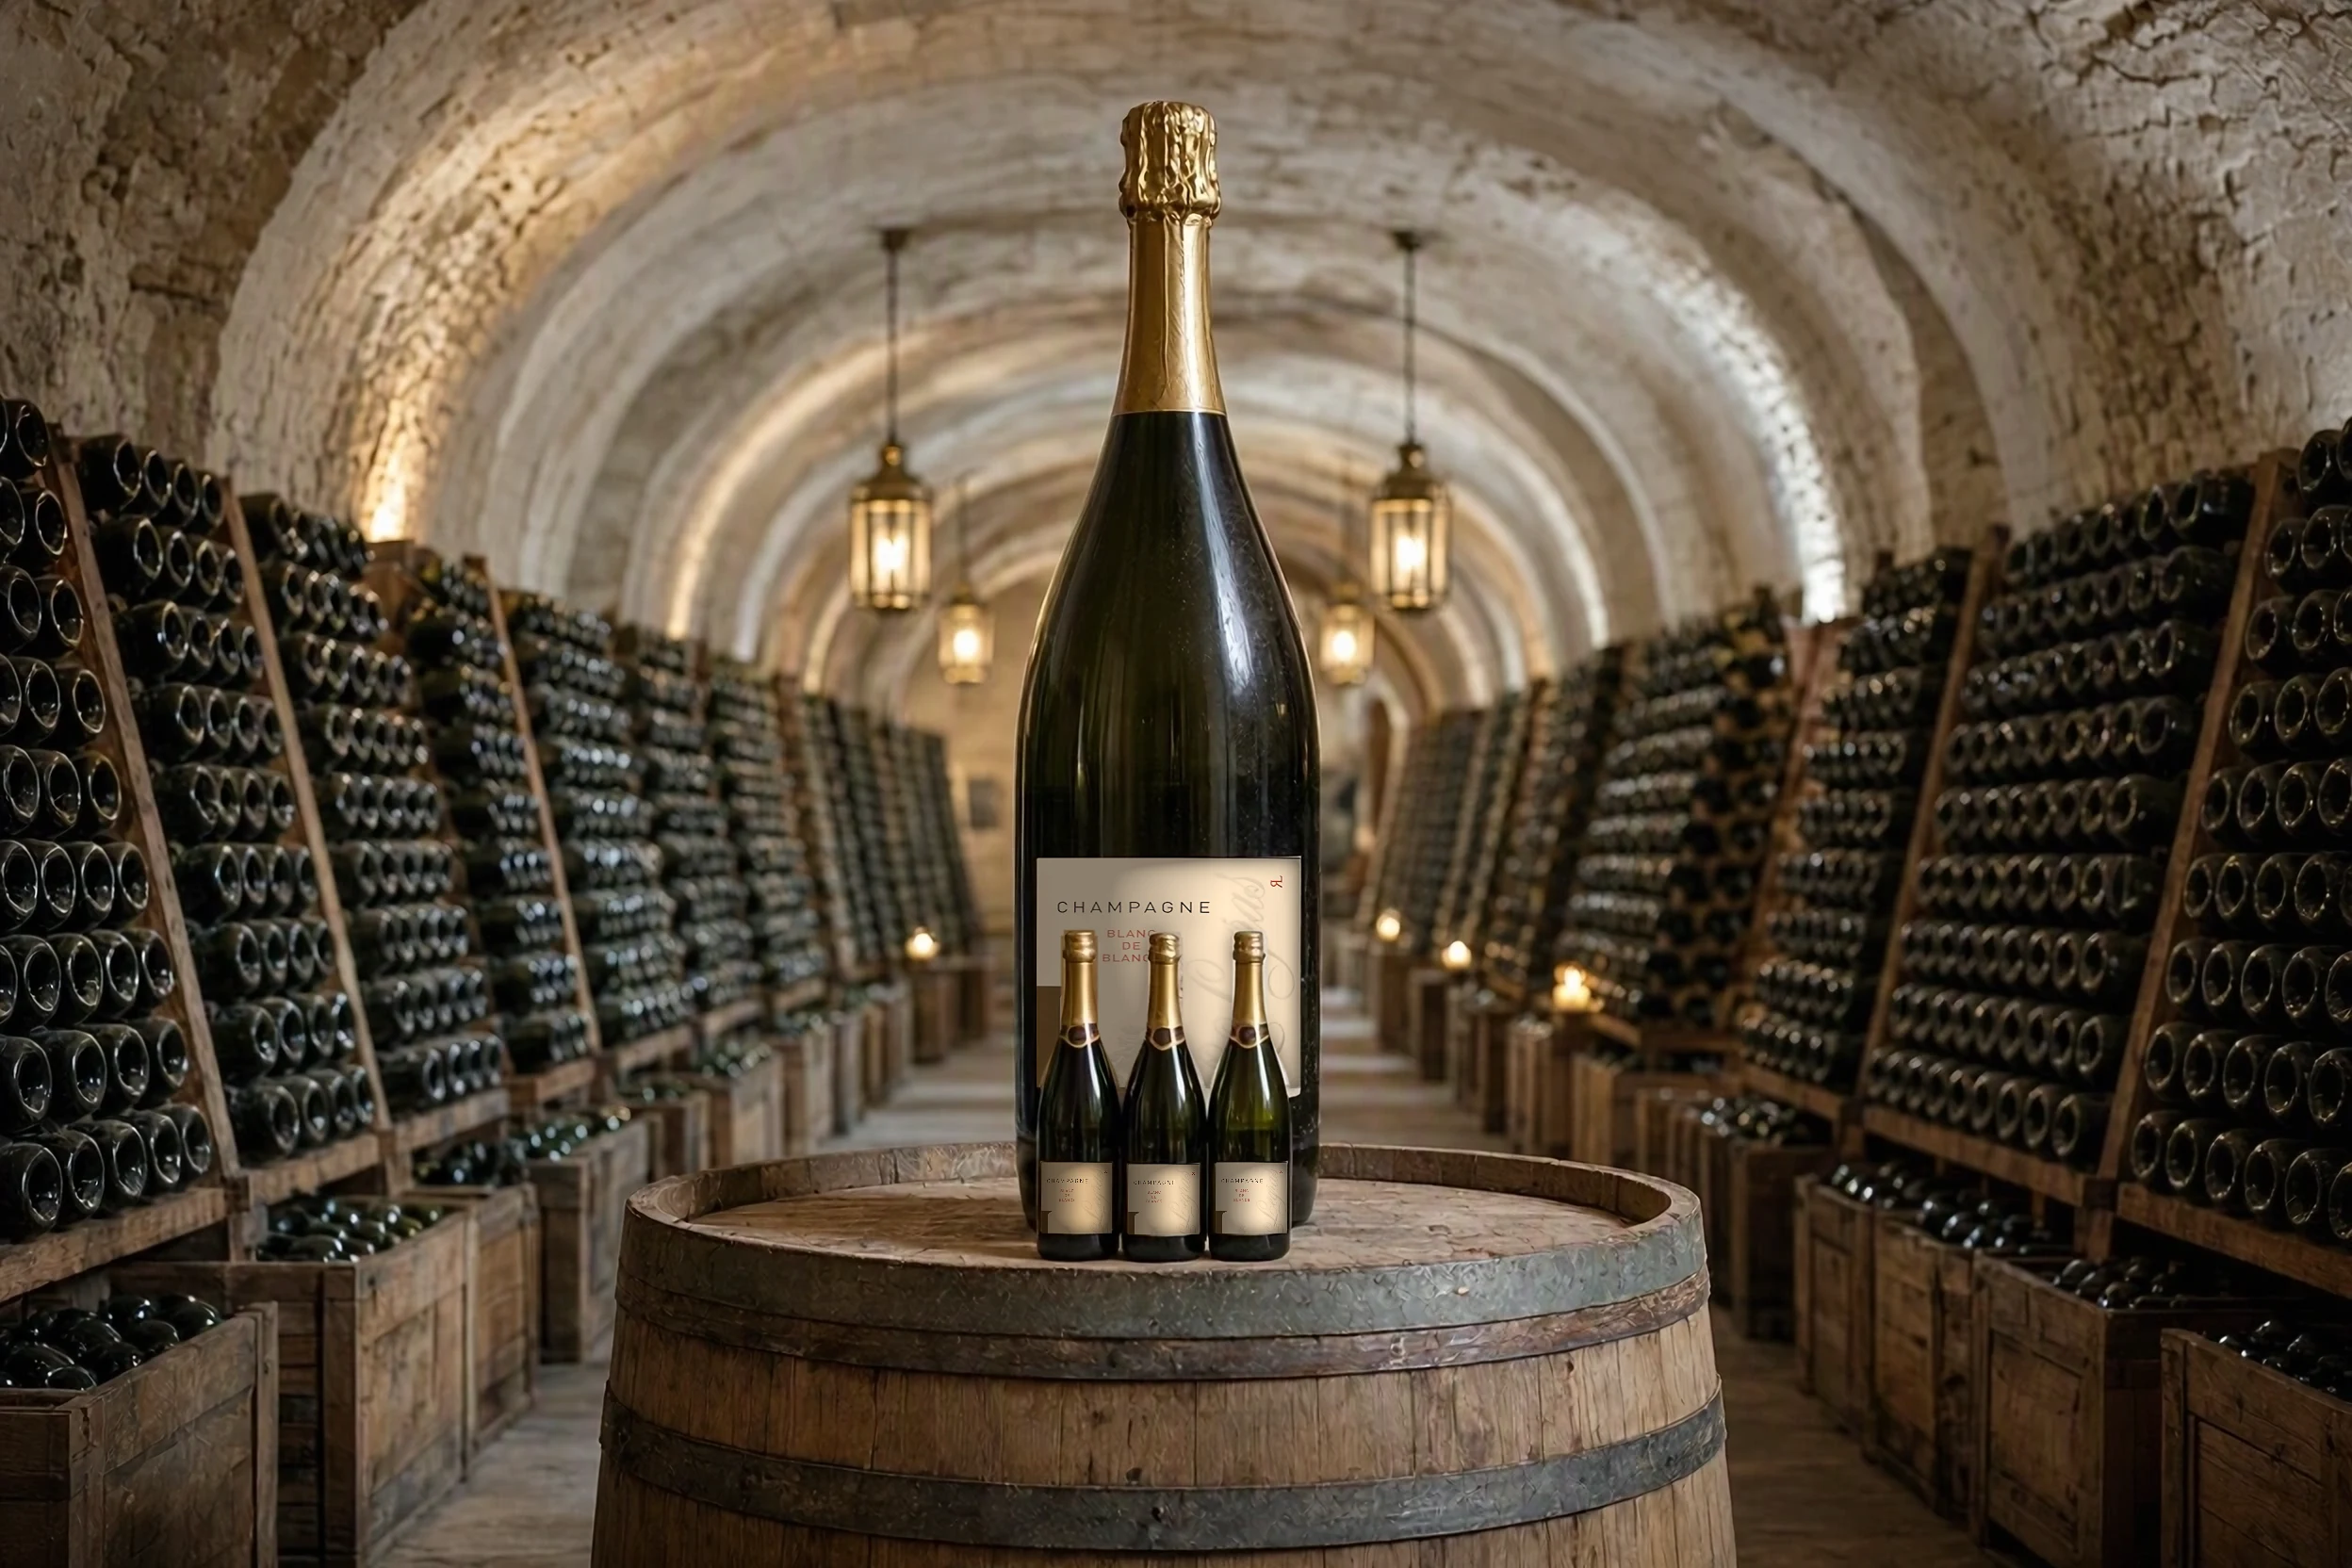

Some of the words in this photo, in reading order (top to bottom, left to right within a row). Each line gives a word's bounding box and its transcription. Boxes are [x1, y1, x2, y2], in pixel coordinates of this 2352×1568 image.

[1056, 901, 1211, 914] CHAMPAGNE
[1121, 941, 1141, 951] DE
[1102, 954, 1149, 962] BLANC
